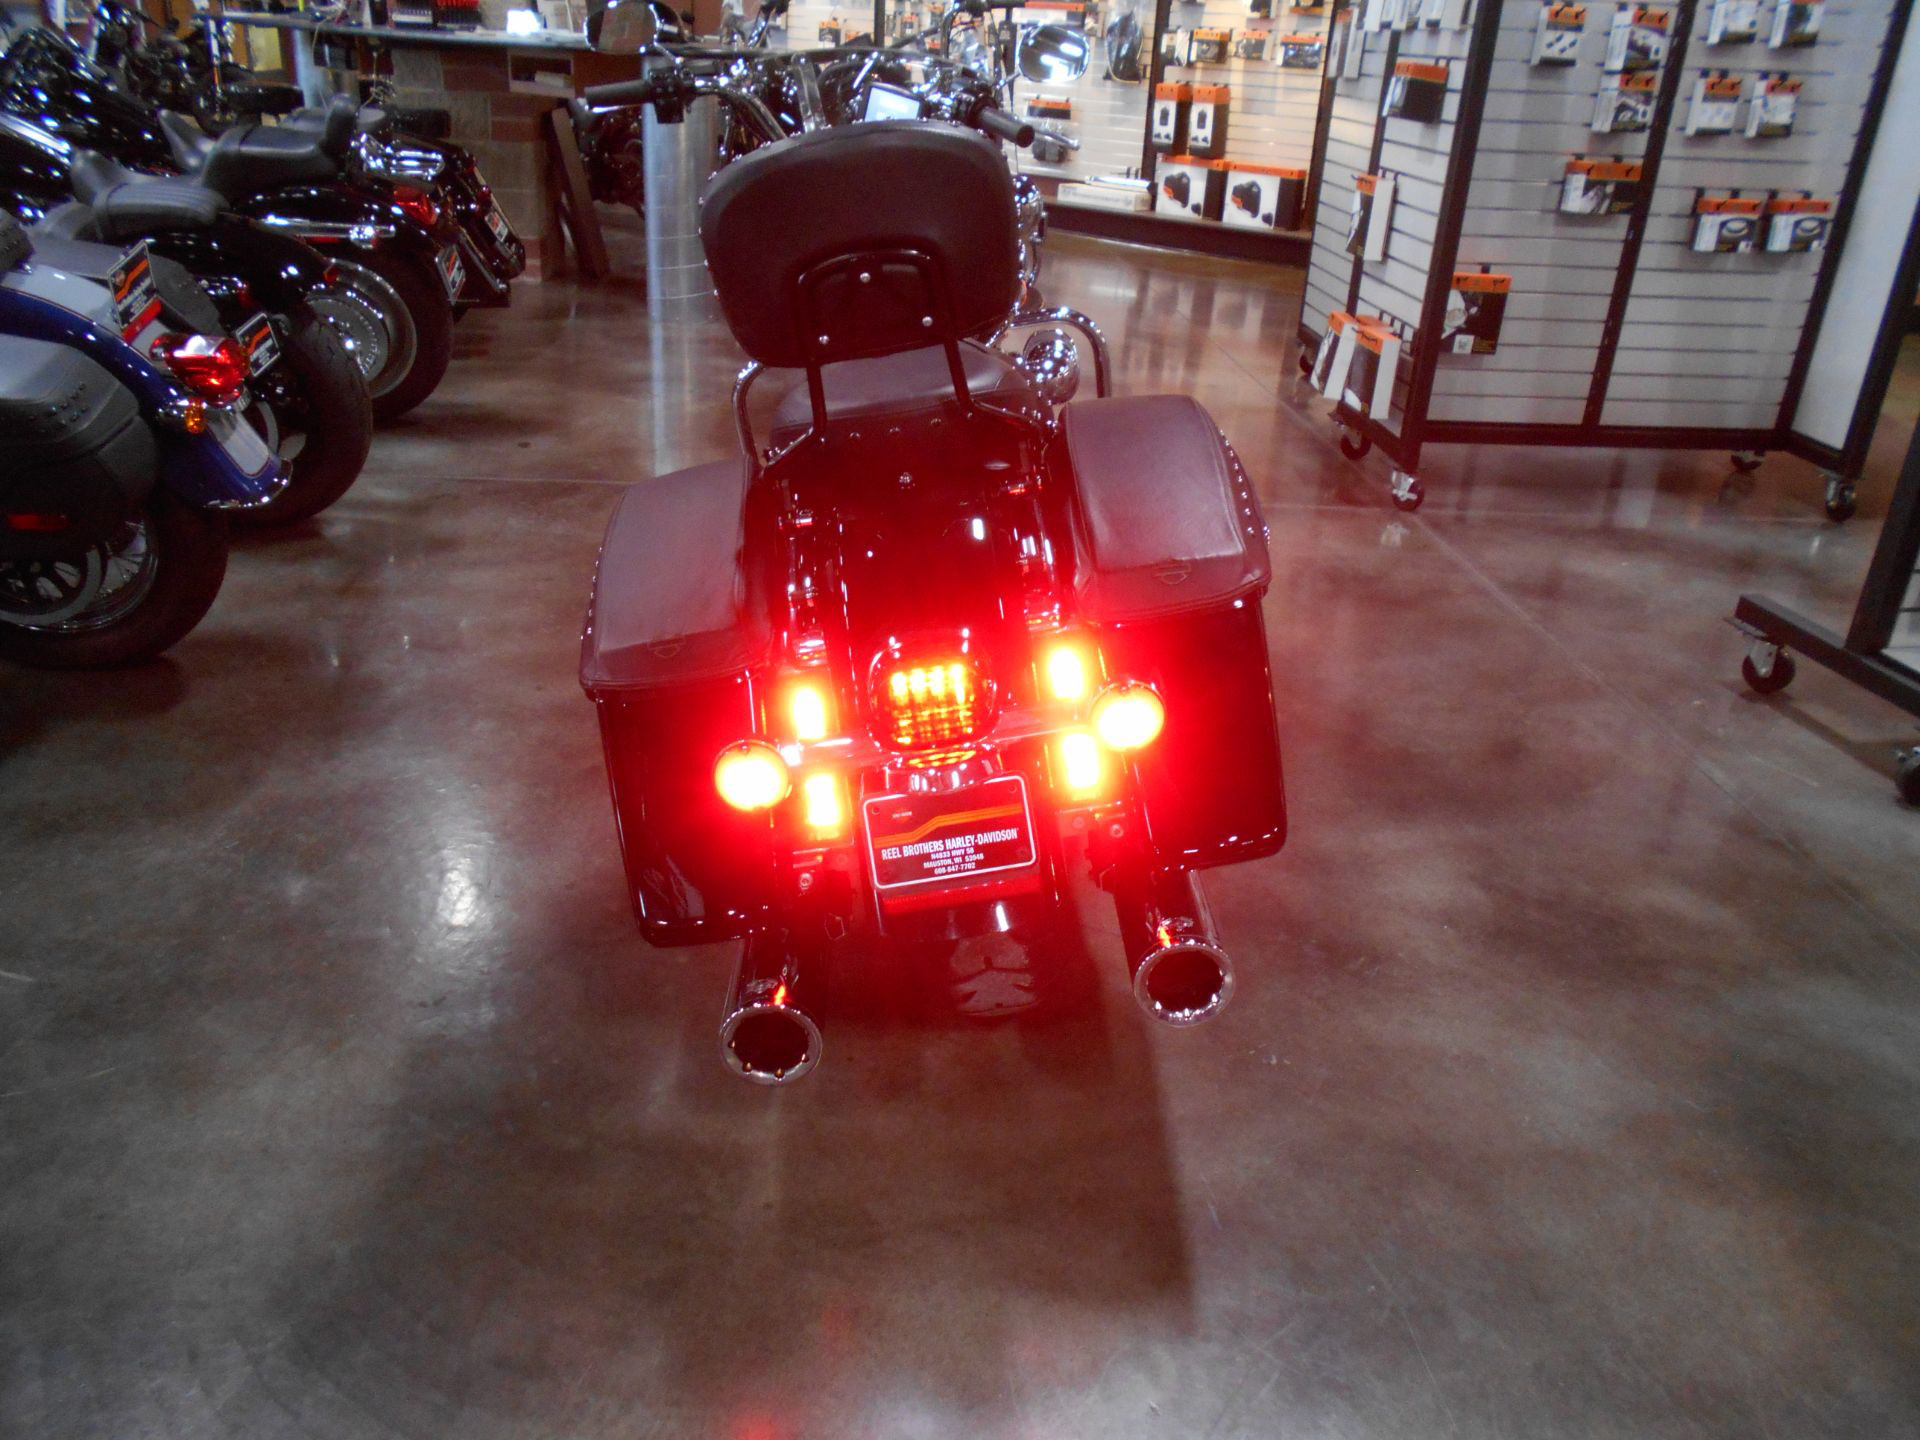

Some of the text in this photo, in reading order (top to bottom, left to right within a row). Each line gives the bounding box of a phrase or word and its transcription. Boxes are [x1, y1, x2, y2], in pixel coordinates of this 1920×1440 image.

[881, 828, 1018, 860] REEL BROTHERS HARLEY-DAVIDSON
